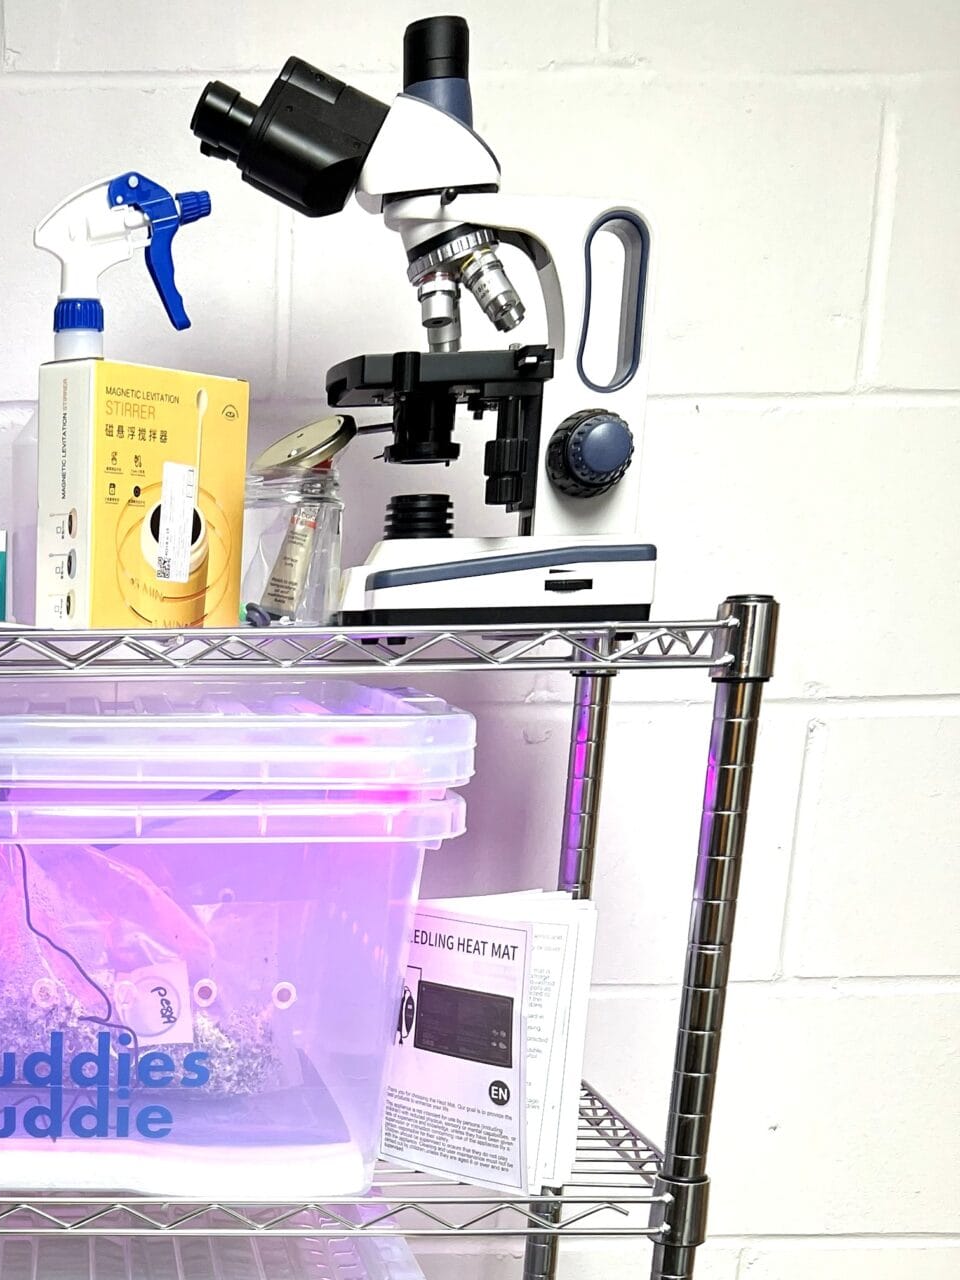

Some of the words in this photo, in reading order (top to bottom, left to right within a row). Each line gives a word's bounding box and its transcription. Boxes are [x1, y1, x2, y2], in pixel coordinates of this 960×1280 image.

[105, 386, 141, 401] MAGNETIC
[142, 389, 179, 405] LEVITATION
[105, 401, 156, 421] STIRRER
[457, 937, 488, 957] HEAT
[491, 944, 518, 961] MAT
[490, 1086, 508, 1102] EN
